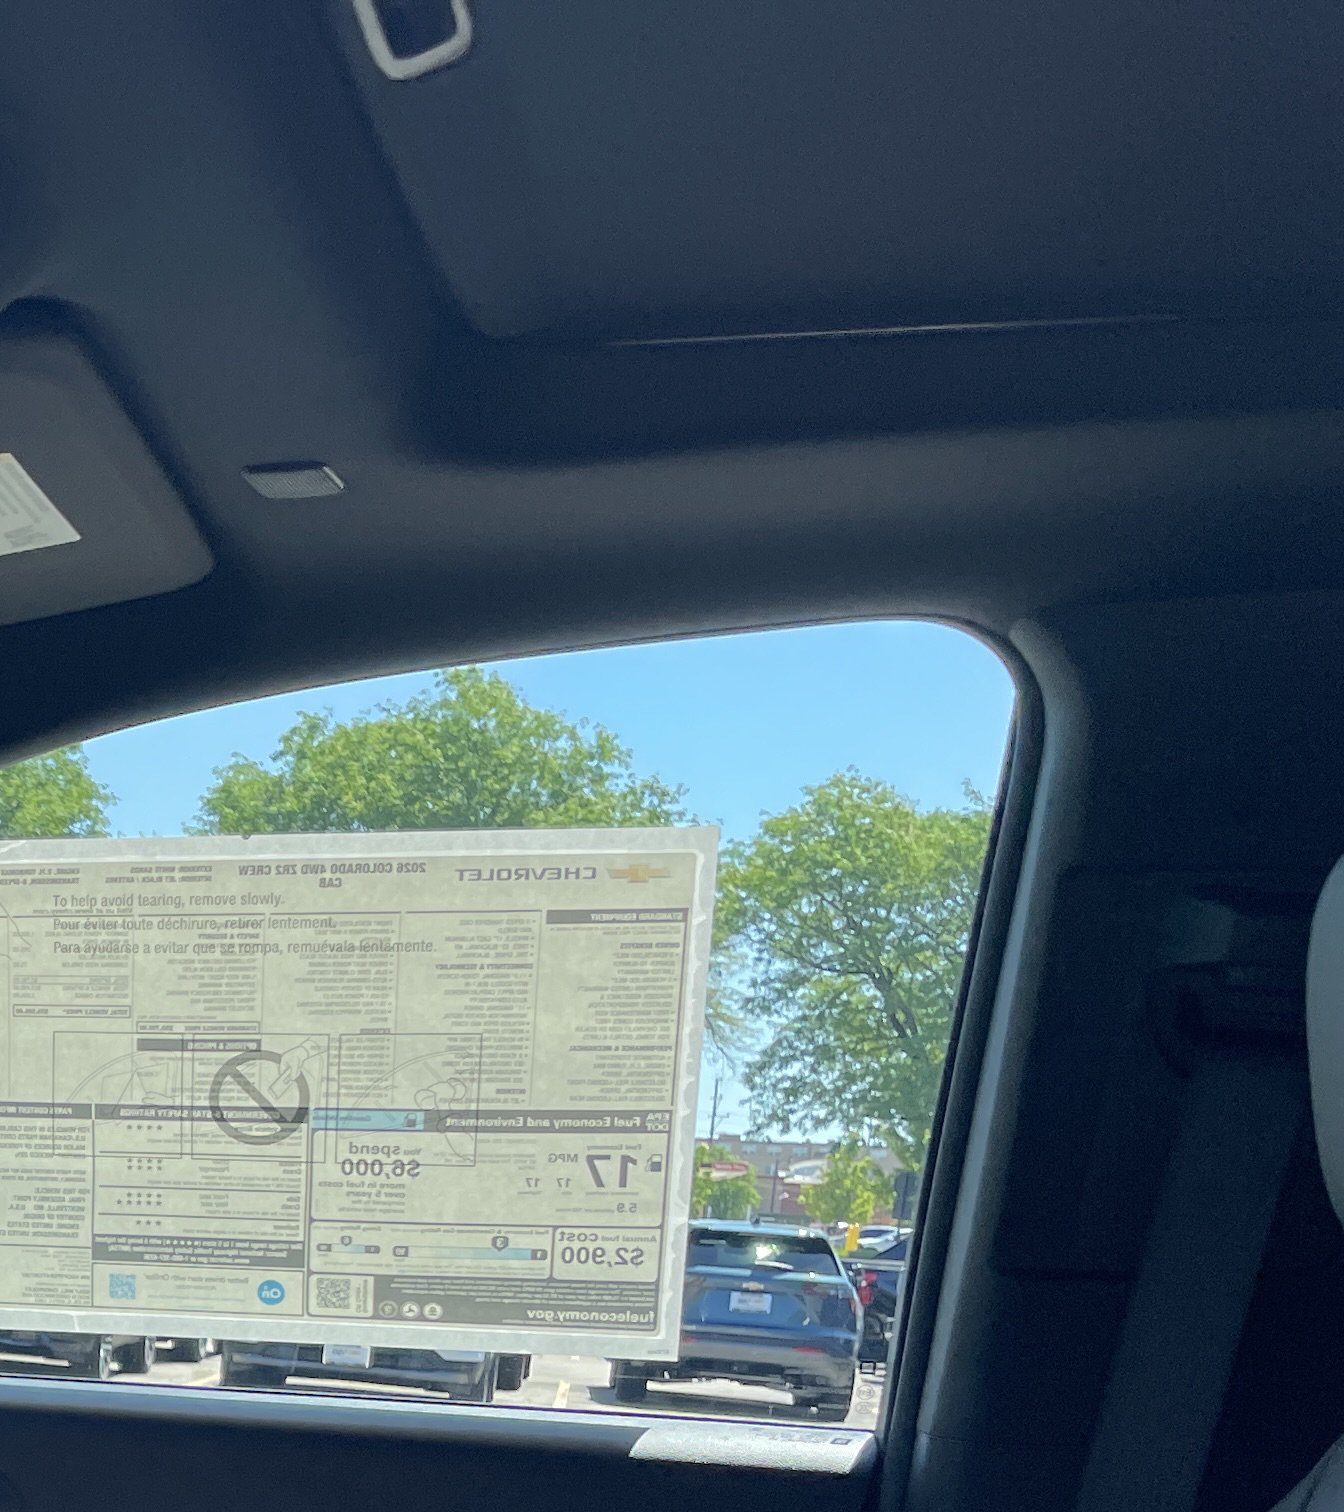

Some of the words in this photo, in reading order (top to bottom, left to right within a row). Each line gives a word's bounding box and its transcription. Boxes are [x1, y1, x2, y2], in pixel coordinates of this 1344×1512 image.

[53, 895, 67, 907] To
[70, 895, 97, 909] help
[101, 894, 134, 907] avoid
[138, 894, 185, 909] tearing,
[189, 895, 236, 906] remove
[240, 892, 285, 907] slowly.
[53, 918, 79, 930] Pour
[84, 918, 118, 930] éviter
[122, 919, 153, 930] toute
[157, 918, 220, 932] déchirure,
[224, 917, 264, 929] retirer
[268, 916, 337, 929] lentement.
[53, 941, 81, 953] Para
[83, 941, 139, 956] ayudarse
[143, 943, 151, 954] a
[154, 941, 188, 954] evitar
[192, 943, 216, 956] que
[220, 943, 235, 954] se
[238, 942, 284, 955] rompa,
[287, 940, 355, 953] remuévala
[359, 939, 437, 953] lentamente.
